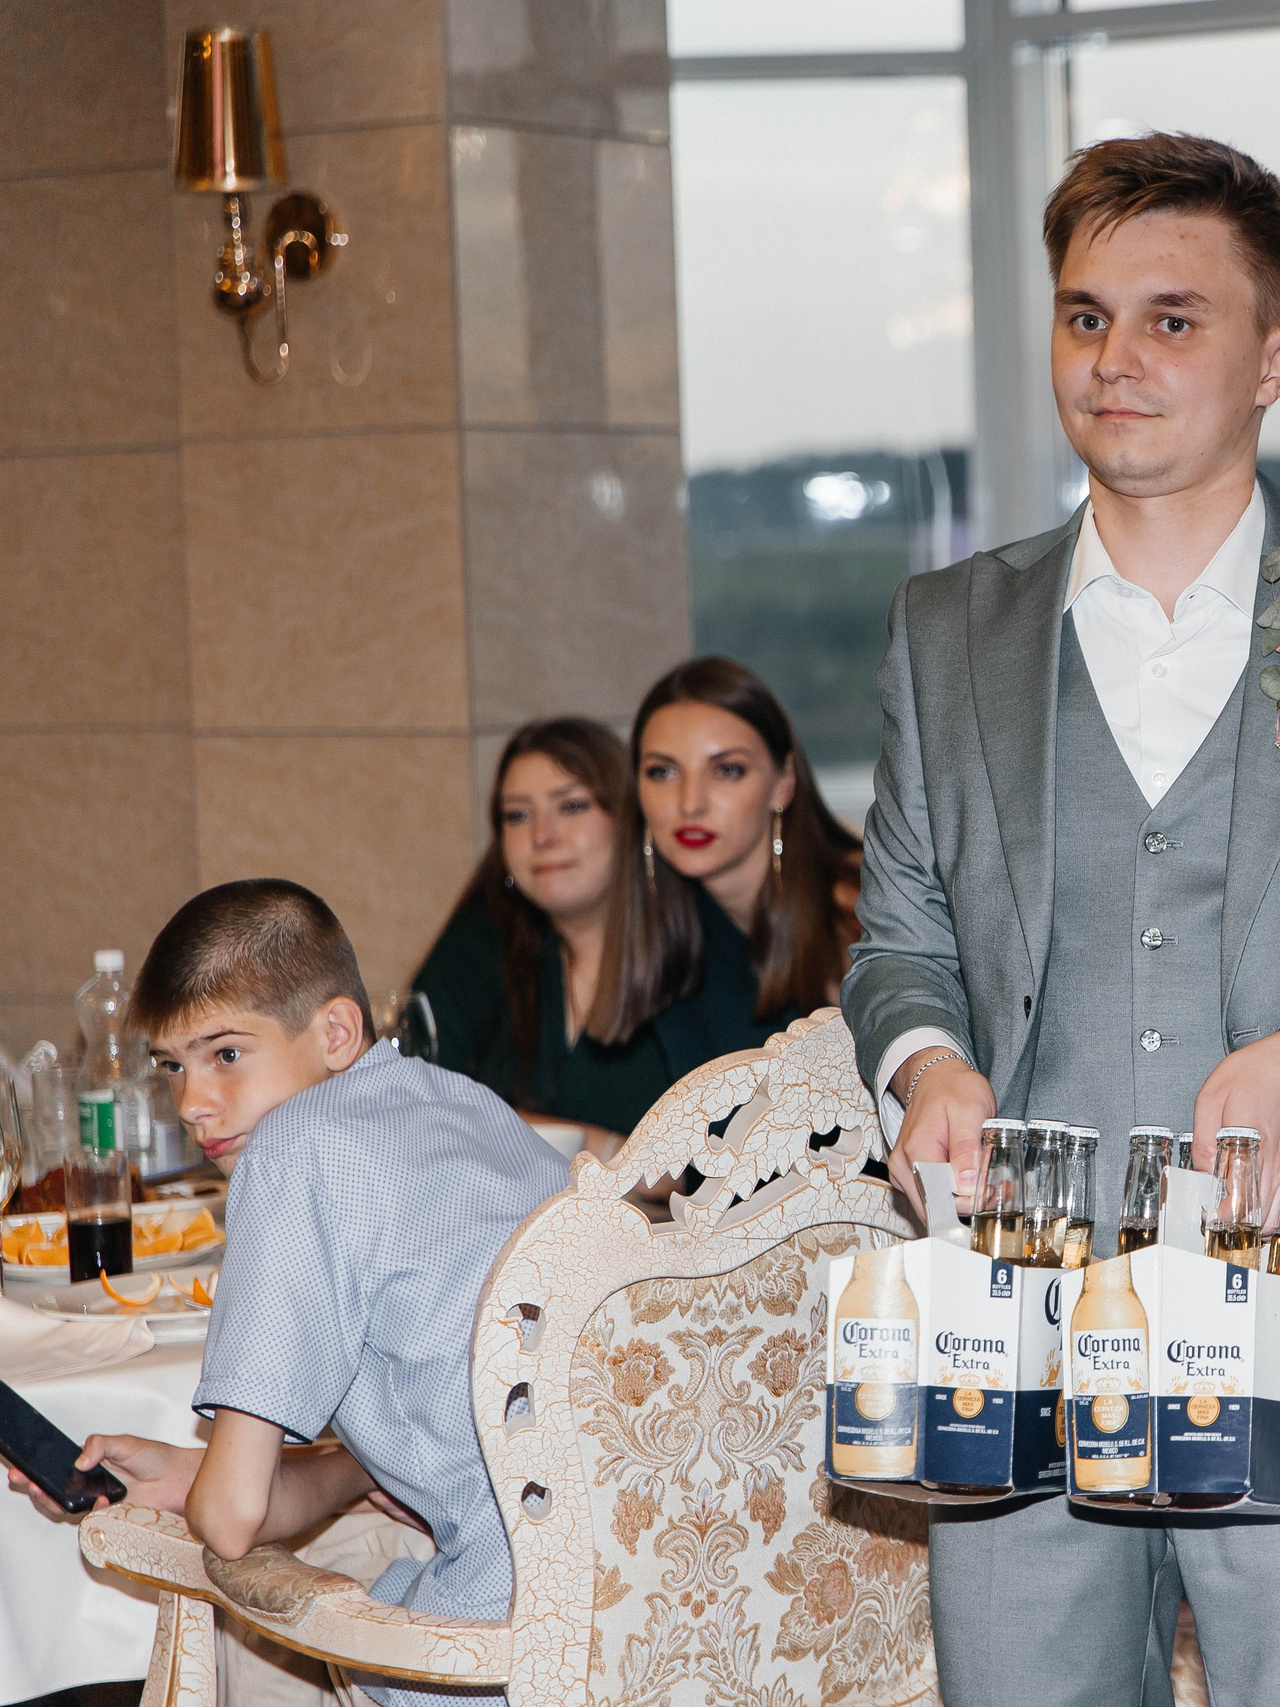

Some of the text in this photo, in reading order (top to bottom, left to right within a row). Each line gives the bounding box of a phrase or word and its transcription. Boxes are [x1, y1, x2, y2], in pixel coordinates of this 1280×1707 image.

[997, 1269, 1007, 1284] 6
[1232, 1273, 1243, 1289] 6
[842, 1321, 911, 1345] Corona
[935, 1330, 1006, 1355] Corona
[1078, 1334, 1141, 1358] Corona
[858, 1343, 899, 1359] Extra
[1167, 1339, 1242, 1363] Corona
[952, 1354, 990, 1371] Extra
[1093, 1355, 1130, 1370] Extra
[1186, 1361, 1226, 1377] Extra
